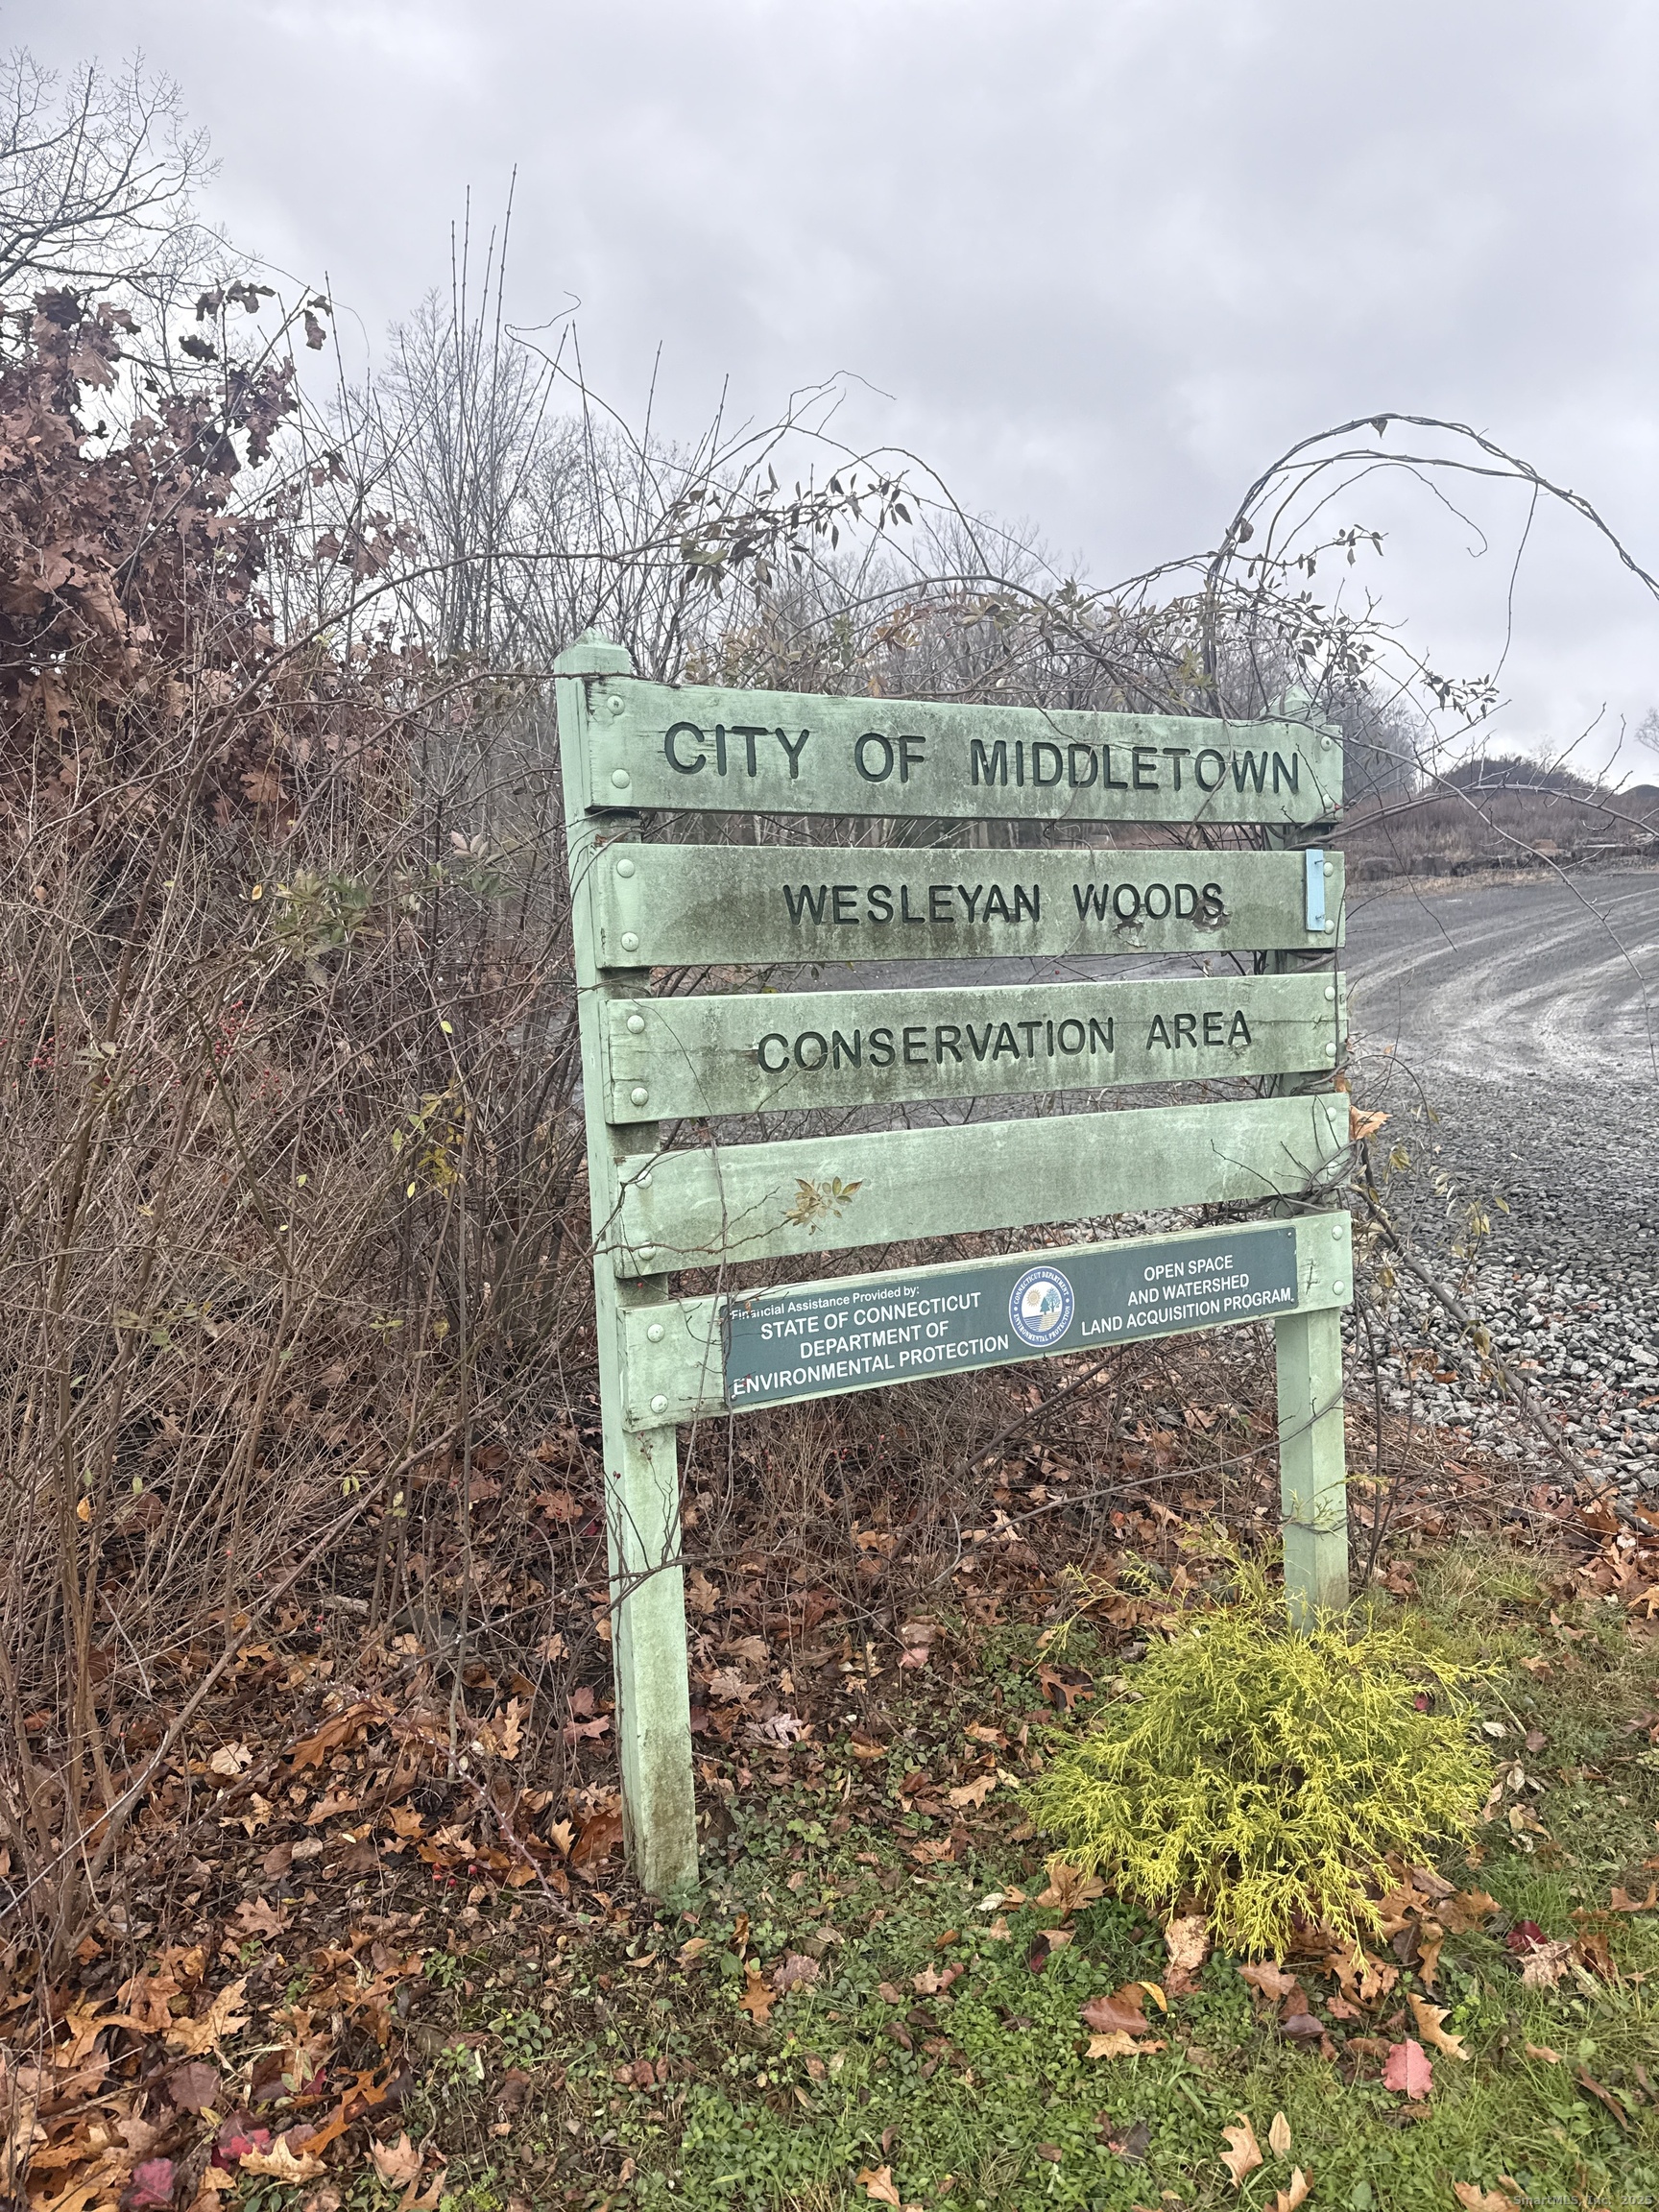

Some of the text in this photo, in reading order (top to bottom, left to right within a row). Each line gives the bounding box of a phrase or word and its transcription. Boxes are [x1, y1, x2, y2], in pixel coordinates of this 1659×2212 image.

[664, 721, 1300, 794] CITY OF MIDDLETOWN
[782, 882, 1224, 926] WESLEYAN WOODS
[758, 1010, 1250, 1073] CONSERVATION AREA
[1143, 1255, 1234, 1282] OPEN SPACE
[787, 1295, 851, 1312] Assistance
[853, 1286, 902, 1303] Provided
[903, 1285, 920, 1298] by:
[1014, 1271, 1070, 1305] CONNECTICUT DEPARTMENT
[1127, 1273, 1249, 1307] AND WATERSHED
[760, 1291, 981, 1340] STATE OF CONNECTICUT
[1014, 1306, 1070, 1342] ENVIRONMENTAL PROTECTION
[1081, 1316, 1122, 1336] LAND
[1126, 1301, 1219, 1330] ACQUISITION
[800, 1320, 949, 1358] DEPARTMENT OF
[733, 1334, 1009, 1396] ENVIRONMENTAL PROTECTION
